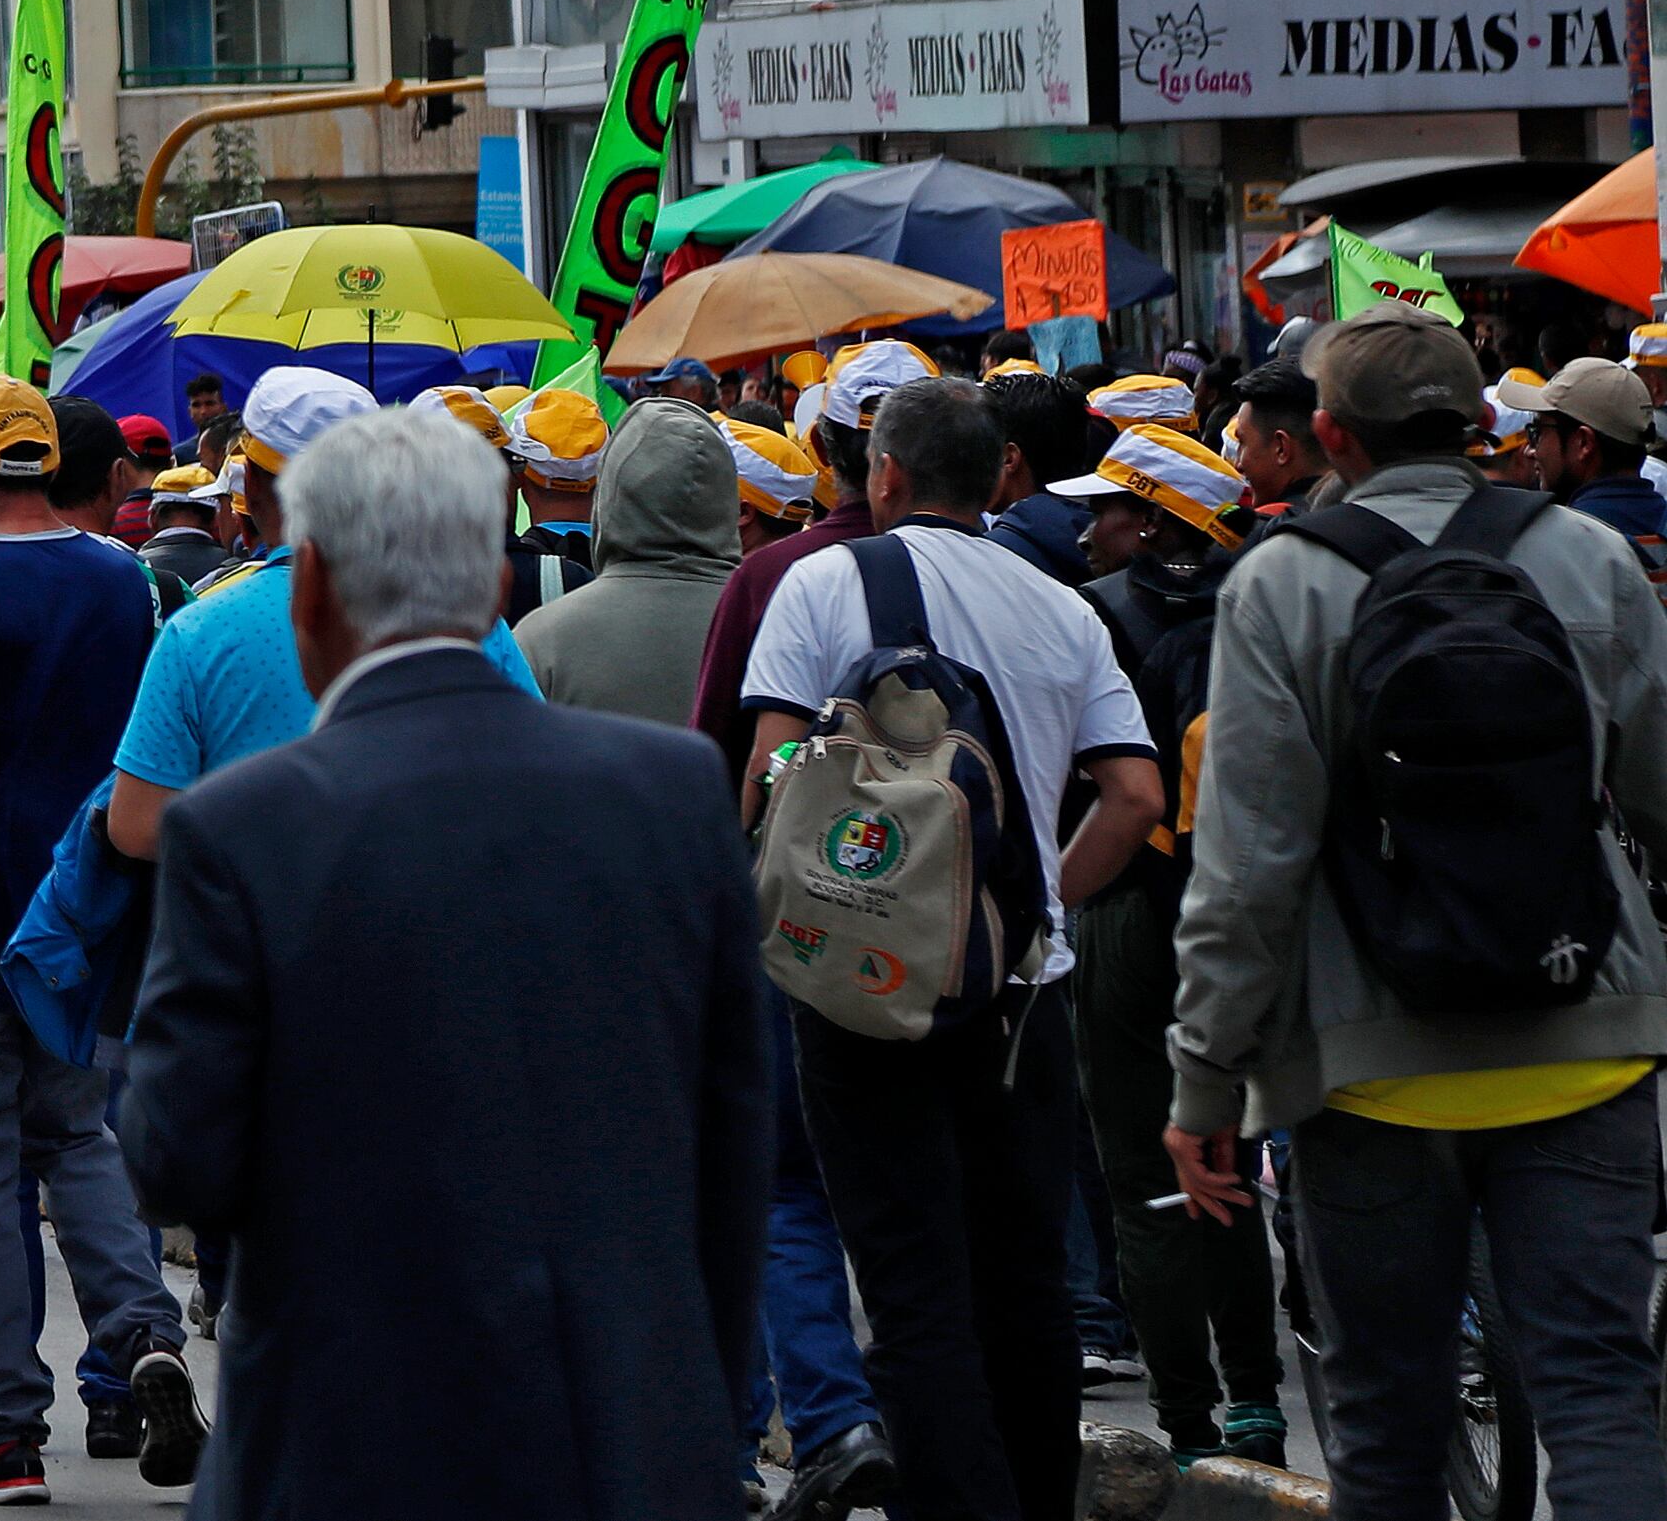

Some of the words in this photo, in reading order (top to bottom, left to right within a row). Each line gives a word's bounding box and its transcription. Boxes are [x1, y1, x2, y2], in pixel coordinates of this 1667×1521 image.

[747, 43, 800, 107] MEDIAS
[809, 39, 853, 103] FAJAS
[907, 32, 966, 98] MEDIAS
[978, 26, 1026, 94] FAJAS
[1282, 8, 1521, 80] MEDIAS
[1548, 5, 1629, 68] FA
[1157, 64, 1191, 105] Las
[1195, 64, 1253, 97] Gatas
[1126, 471, 1161, 497] CGT
